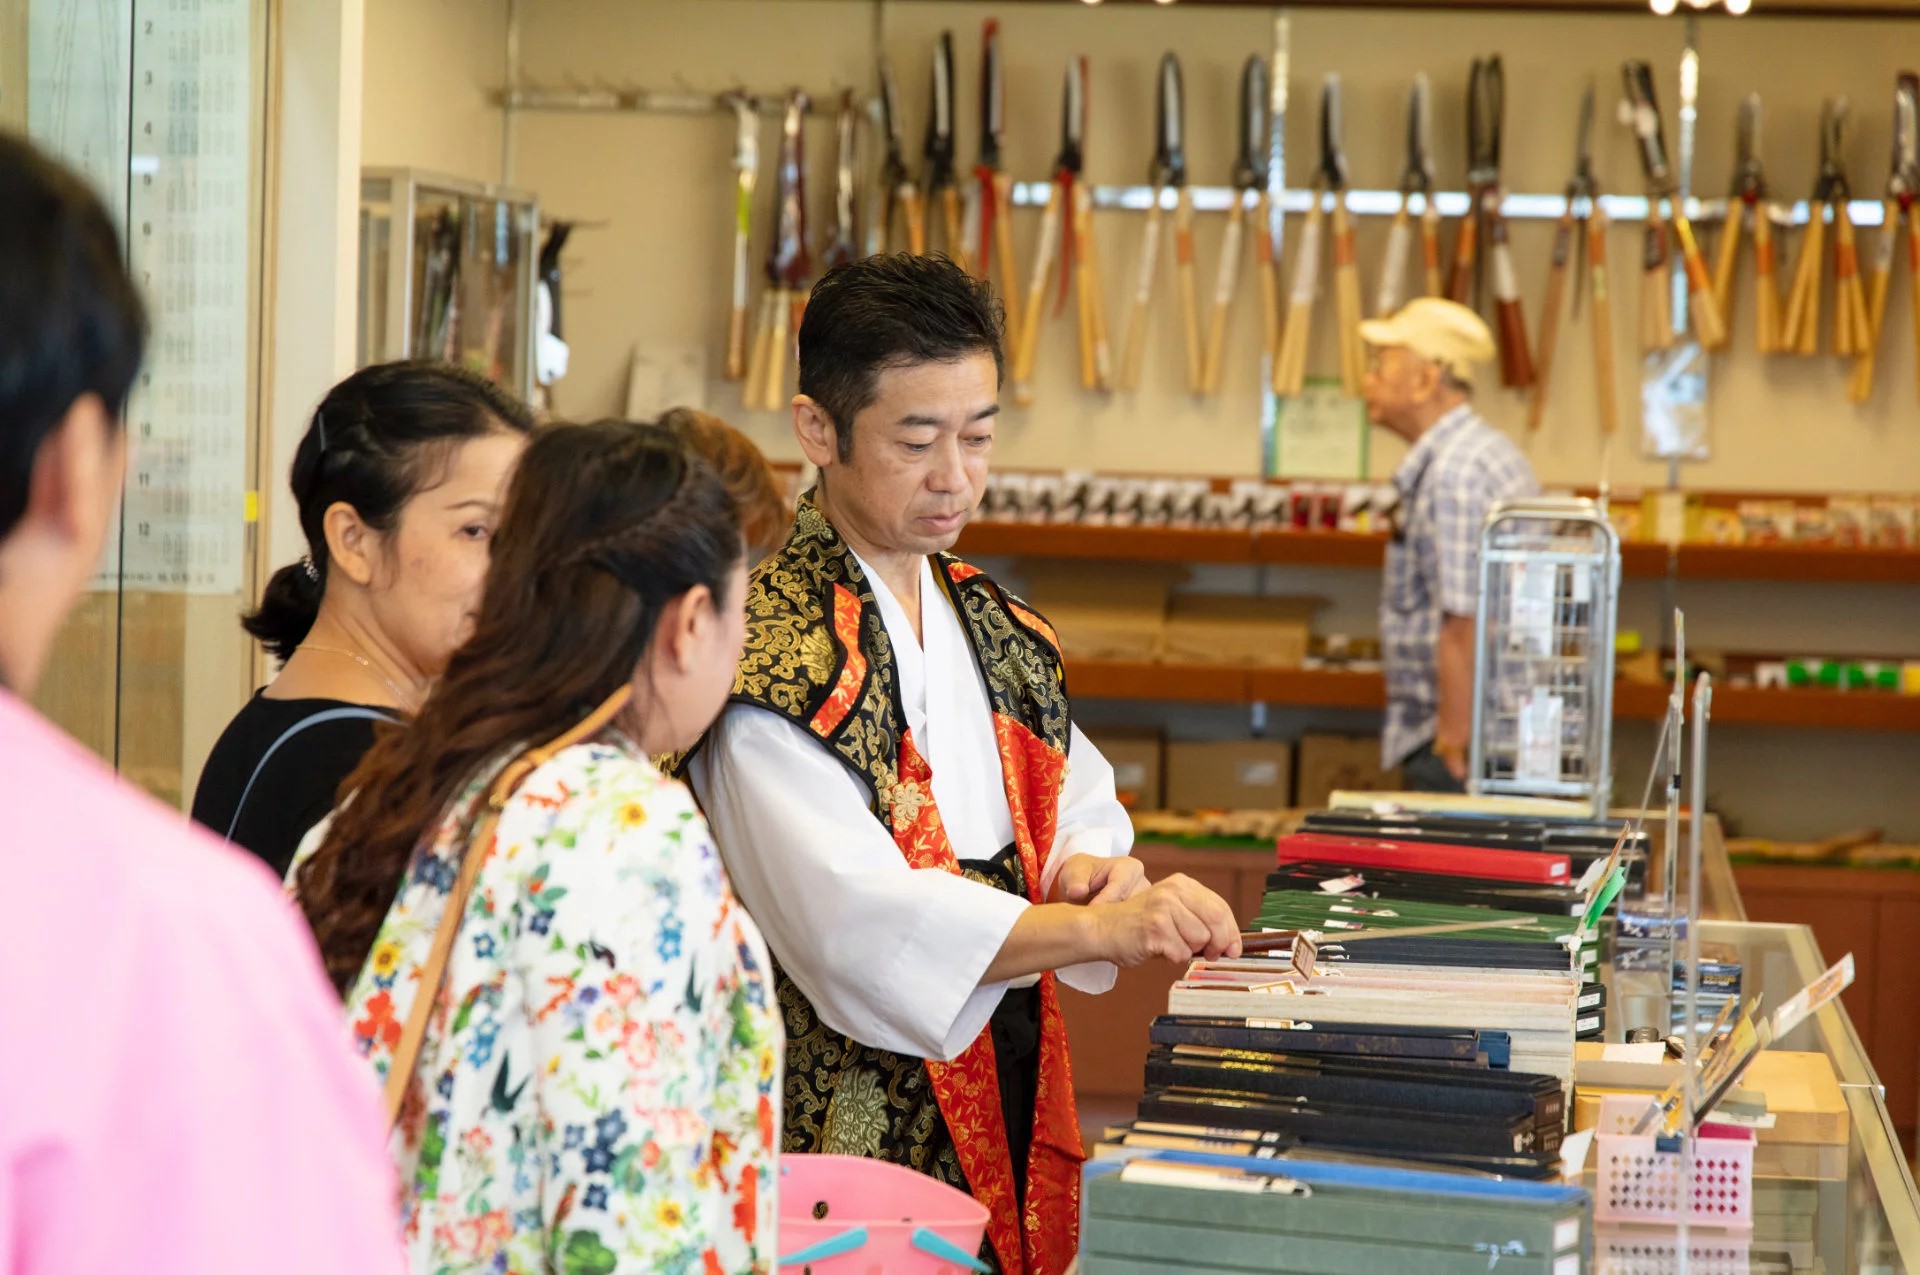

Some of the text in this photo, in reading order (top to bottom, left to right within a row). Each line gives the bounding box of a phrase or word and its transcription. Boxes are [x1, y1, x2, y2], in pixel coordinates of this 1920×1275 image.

[145, 20, 153, 35] 2
[145, 71, 152, 86] 3
[144, 121, 152, 135] 4
[143, 271, 151, 286] 7
[140, 422, 151, 436] 10
[139, 472, 150, 486] 11
[139, 522, 150, 536] 12
